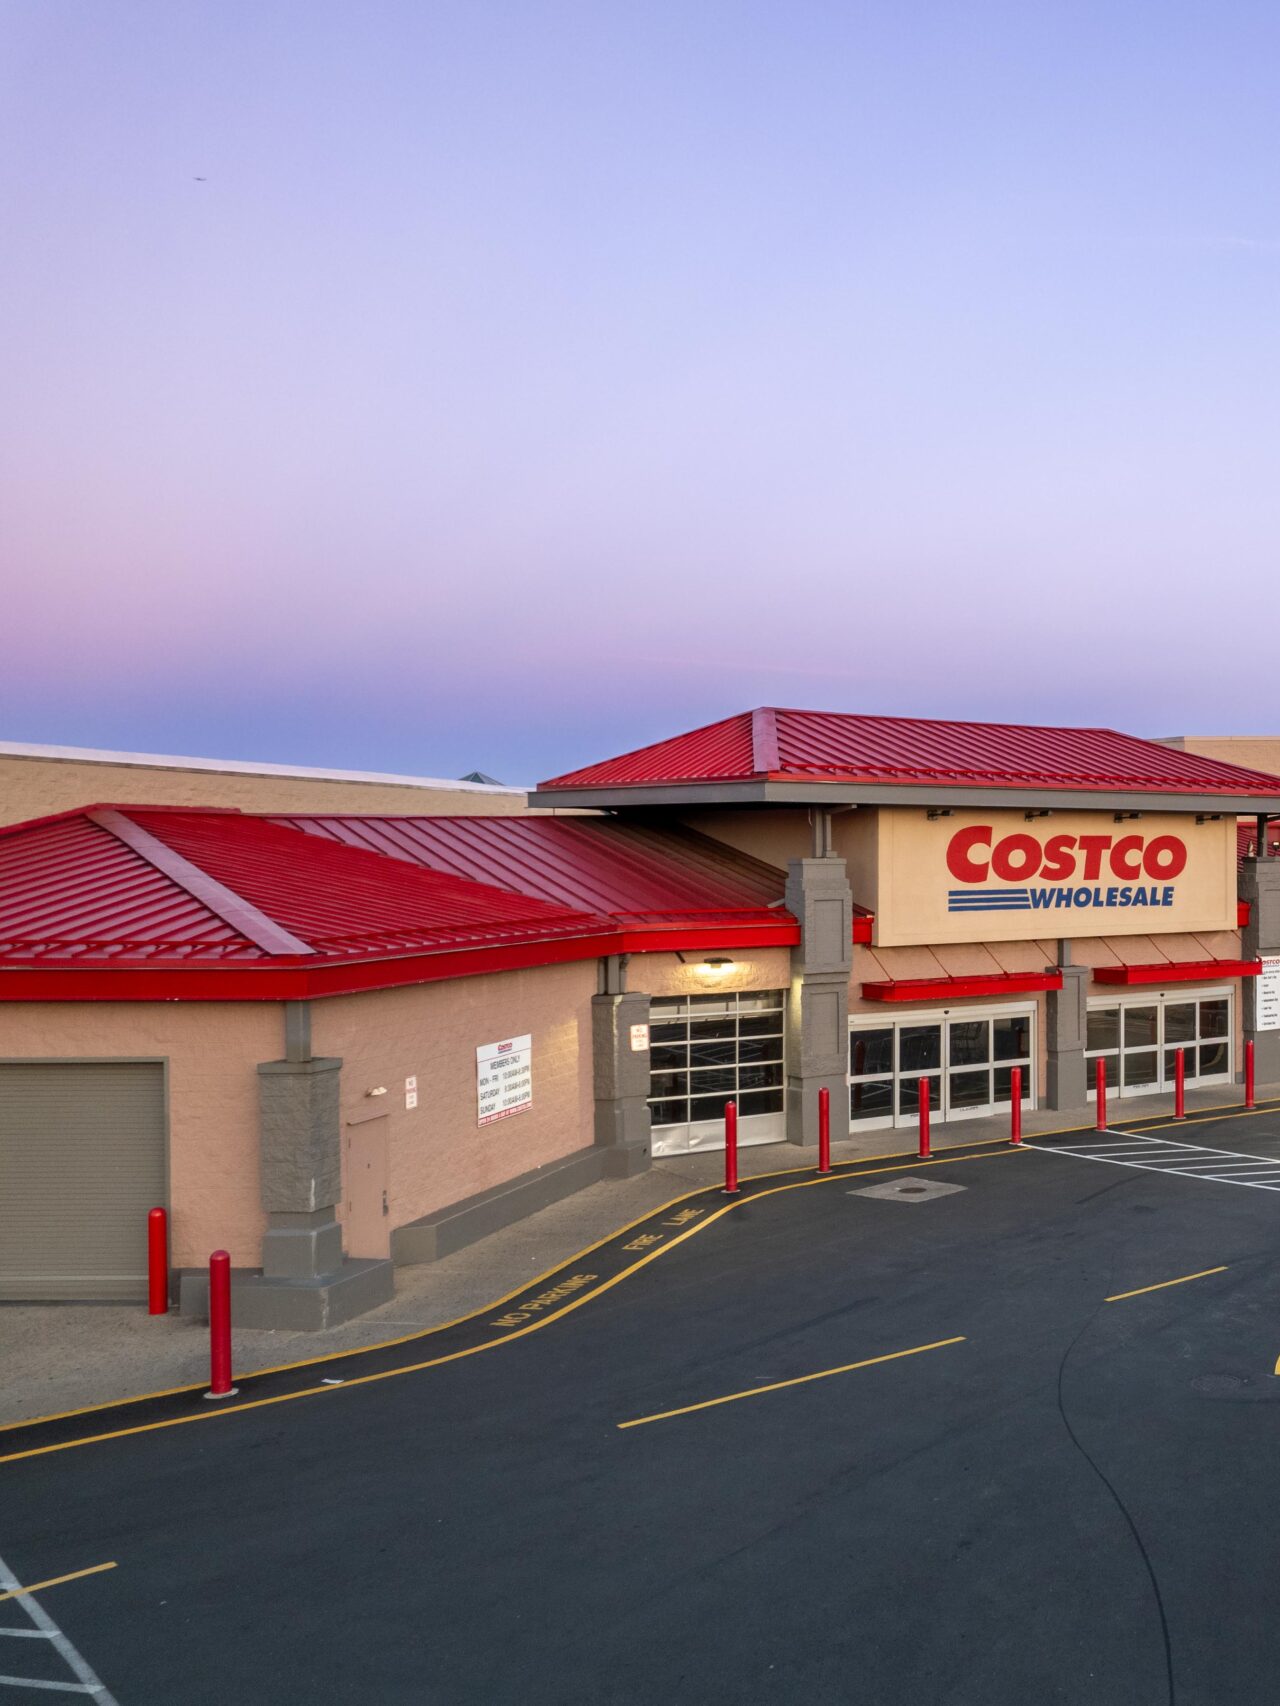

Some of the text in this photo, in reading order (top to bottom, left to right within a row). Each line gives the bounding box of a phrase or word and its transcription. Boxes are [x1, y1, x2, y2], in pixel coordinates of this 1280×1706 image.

[946, 825, 1187, 883] COSTCO
[1030, 886, 1175, 909] WHOLESALE
[621, 1208, 705, 1251] FIRE LANE
[489, 1274, 599, 1327] NO PARKING
